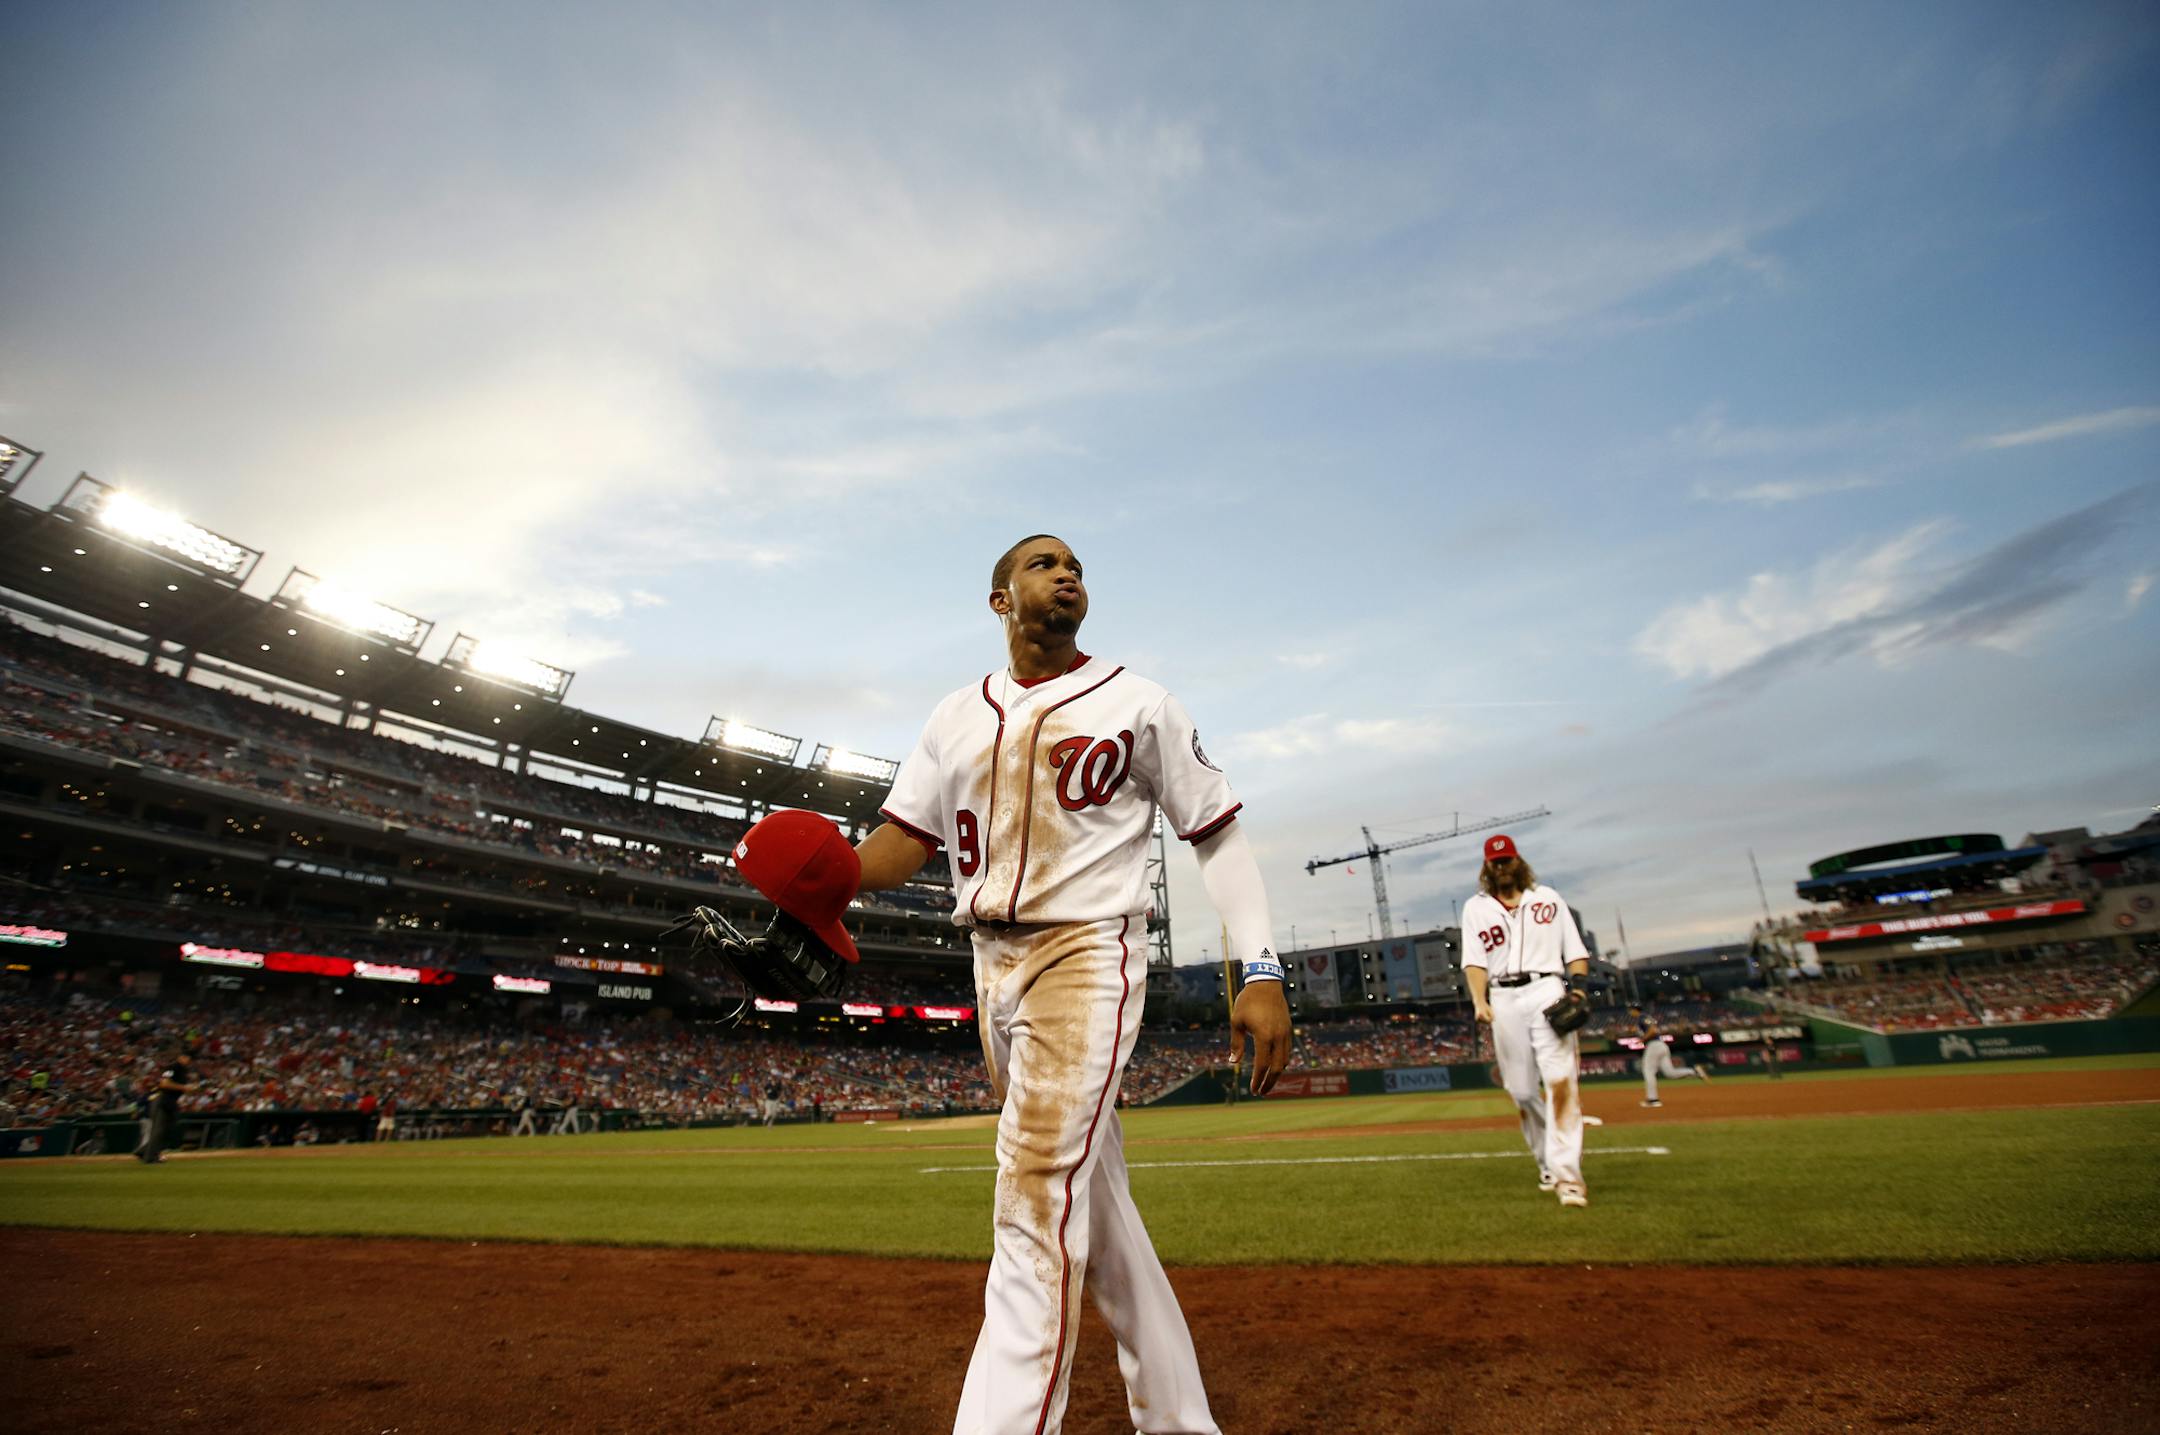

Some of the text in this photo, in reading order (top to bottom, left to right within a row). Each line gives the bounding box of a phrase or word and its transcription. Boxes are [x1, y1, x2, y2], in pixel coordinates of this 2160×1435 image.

[1049, 729, 1134, 812] W
[956, 809, 981, 877] 9
[1478, 924, 1505, 953] 28
[598, 984, 653, 1001] ISLAND PUB
[1401, 1070, 1449, 1087] INOVA
